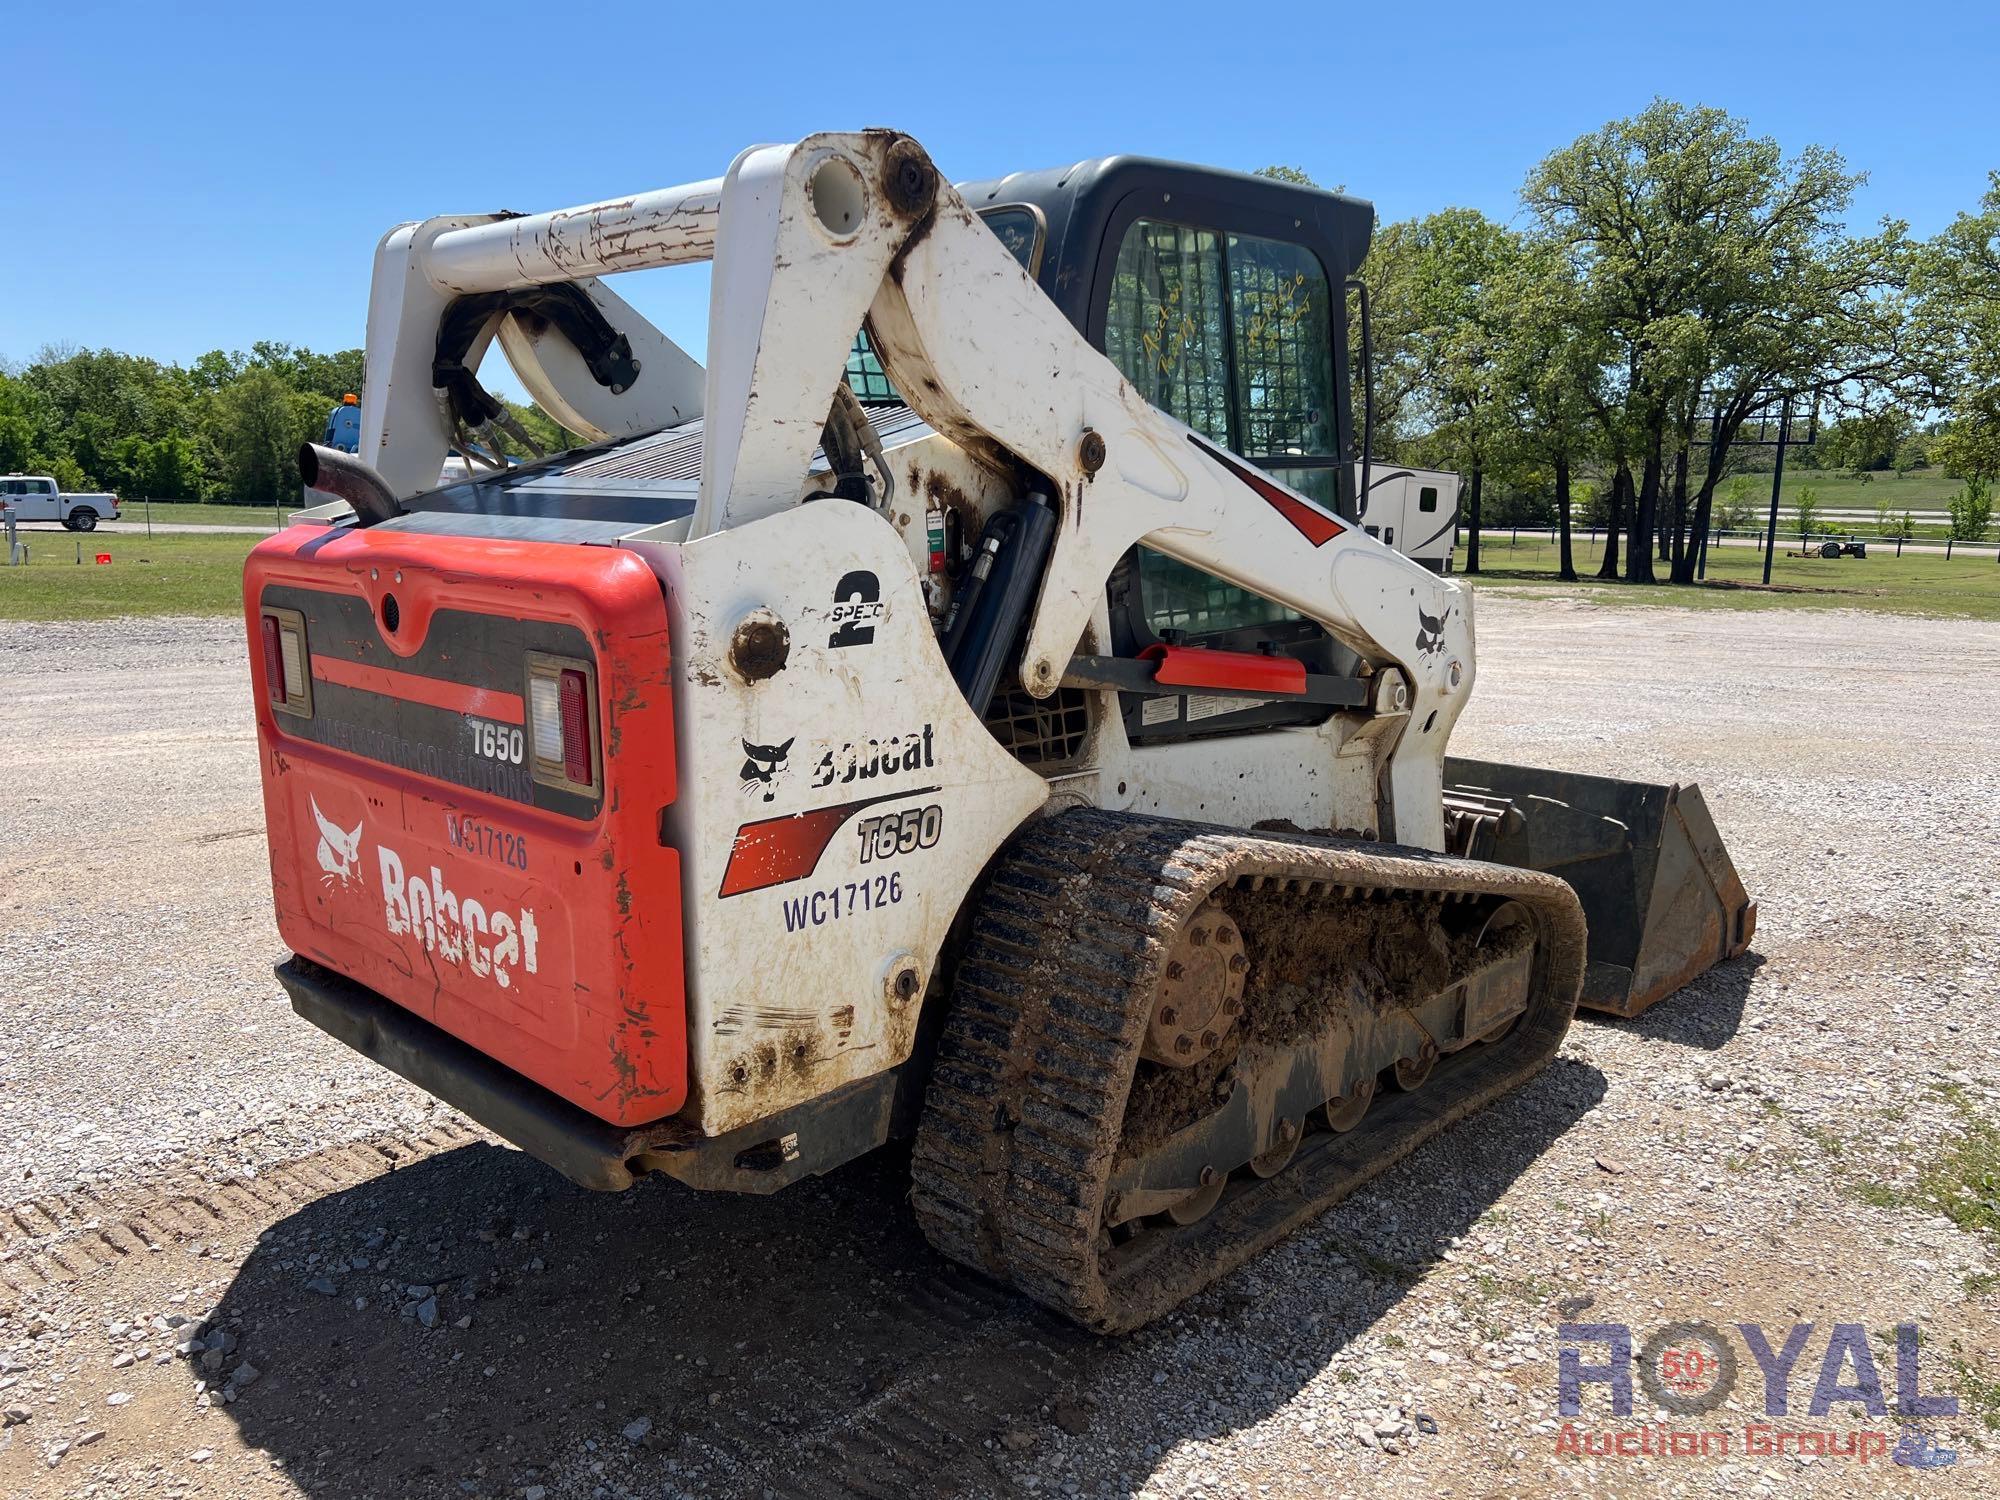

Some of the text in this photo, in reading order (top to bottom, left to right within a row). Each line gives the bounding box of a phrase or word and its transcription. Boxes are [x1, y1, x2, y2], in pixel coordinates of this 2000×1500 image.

[828, 570, 880, 649] 2
[471, 720, 524, 765] T650
[447, 811, 528, 871] WC17126
[858, 804, 943, 864] T650
[378, 845, 539, 989] Bobcat
[783, 872, 903, 933] WC17126
